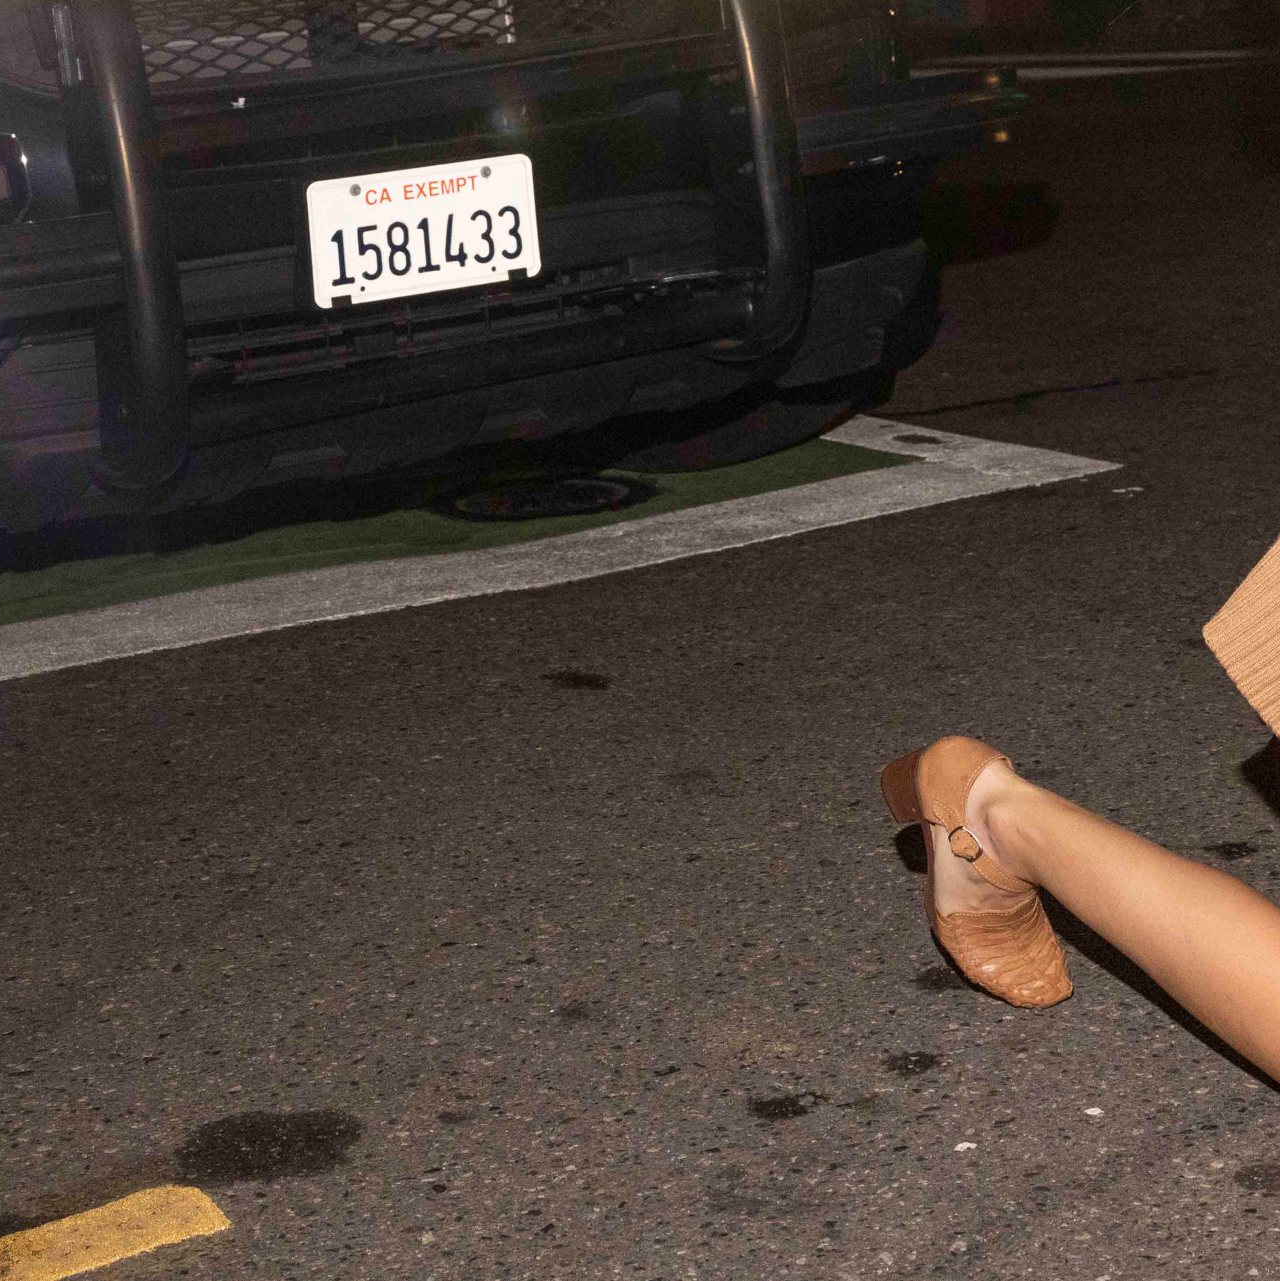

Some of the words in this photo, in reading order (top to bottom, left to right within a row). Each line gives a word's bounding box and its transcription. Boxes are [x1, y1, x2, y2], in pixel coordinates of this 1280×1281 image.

[365, 189, 392, 206] CA
[403, 175, 478, 200] EXEMPT
[330, 205, 523, 287] 1581433
